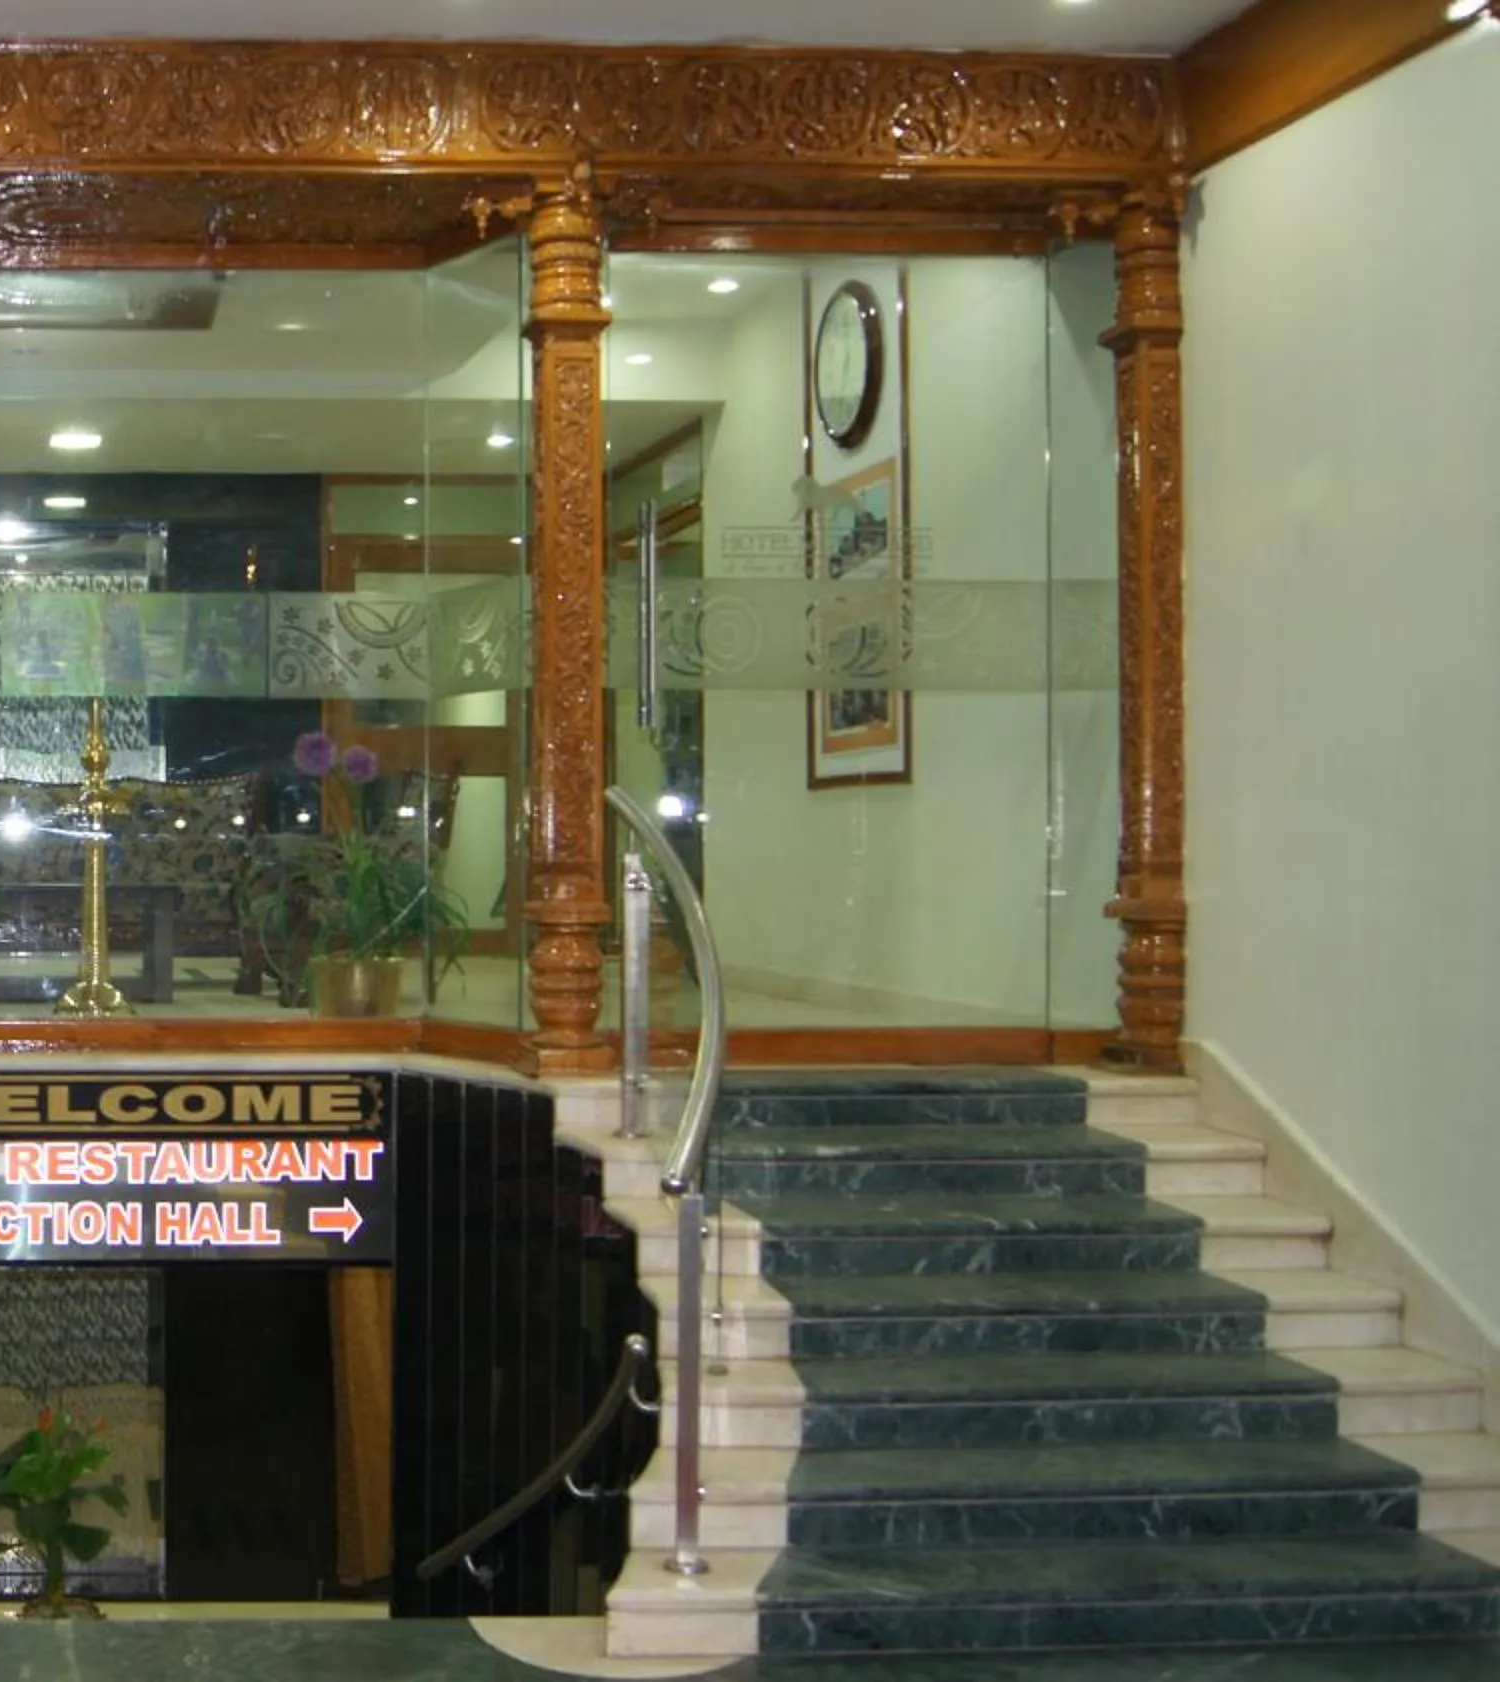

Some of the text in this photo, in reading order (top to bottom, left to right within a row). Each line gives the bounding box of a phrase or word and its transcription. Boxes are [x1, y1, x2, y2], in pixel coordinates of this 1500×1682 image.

[725, 533, 796, 551] HOTEL
[4, 1140, 384, 1184] RESTAURANT
[155, 1201, 281, 1246] HALL
